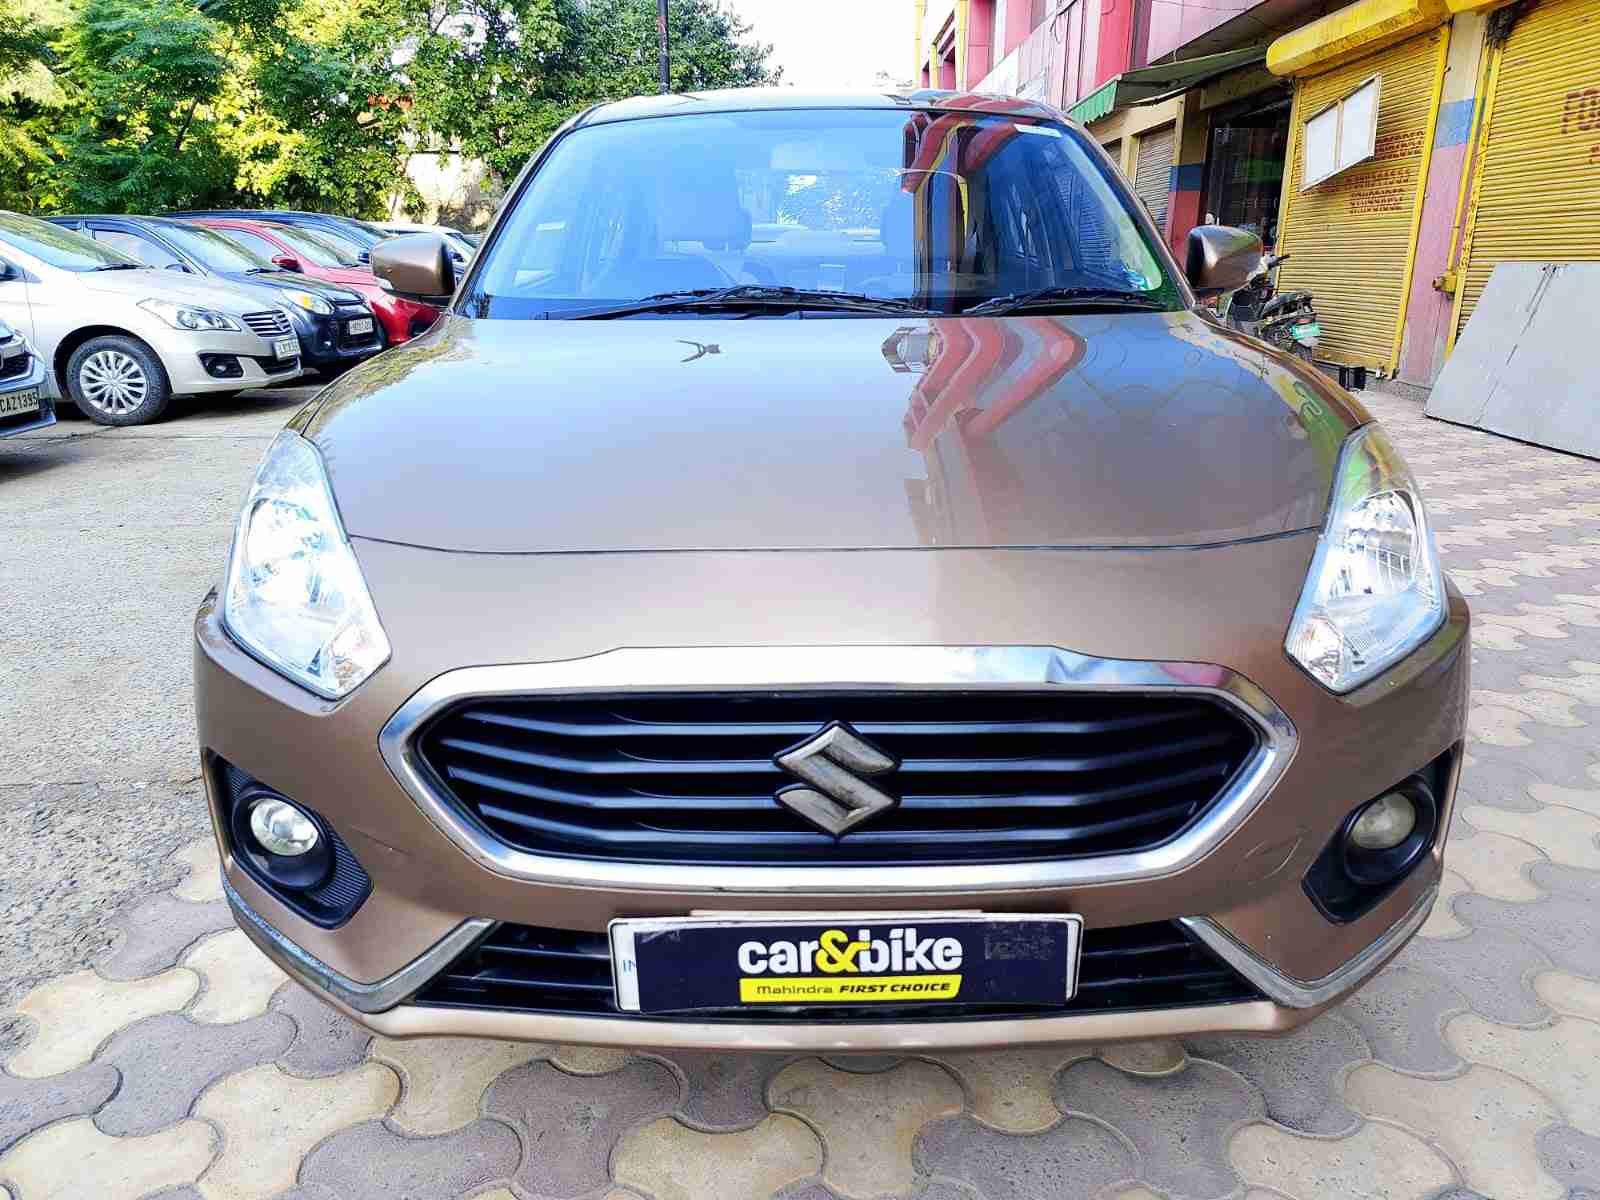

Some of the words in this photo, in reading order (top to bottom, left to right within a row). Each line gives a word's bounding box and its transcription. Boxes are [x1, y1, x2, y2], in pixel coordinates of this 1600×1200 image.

[738, 928, 963, 974] car&bike
[756, 984, 833, 995] Mahindra
[839, 983, 886, 994] FIRST
[890, 981, 951, 993] CHOICE
